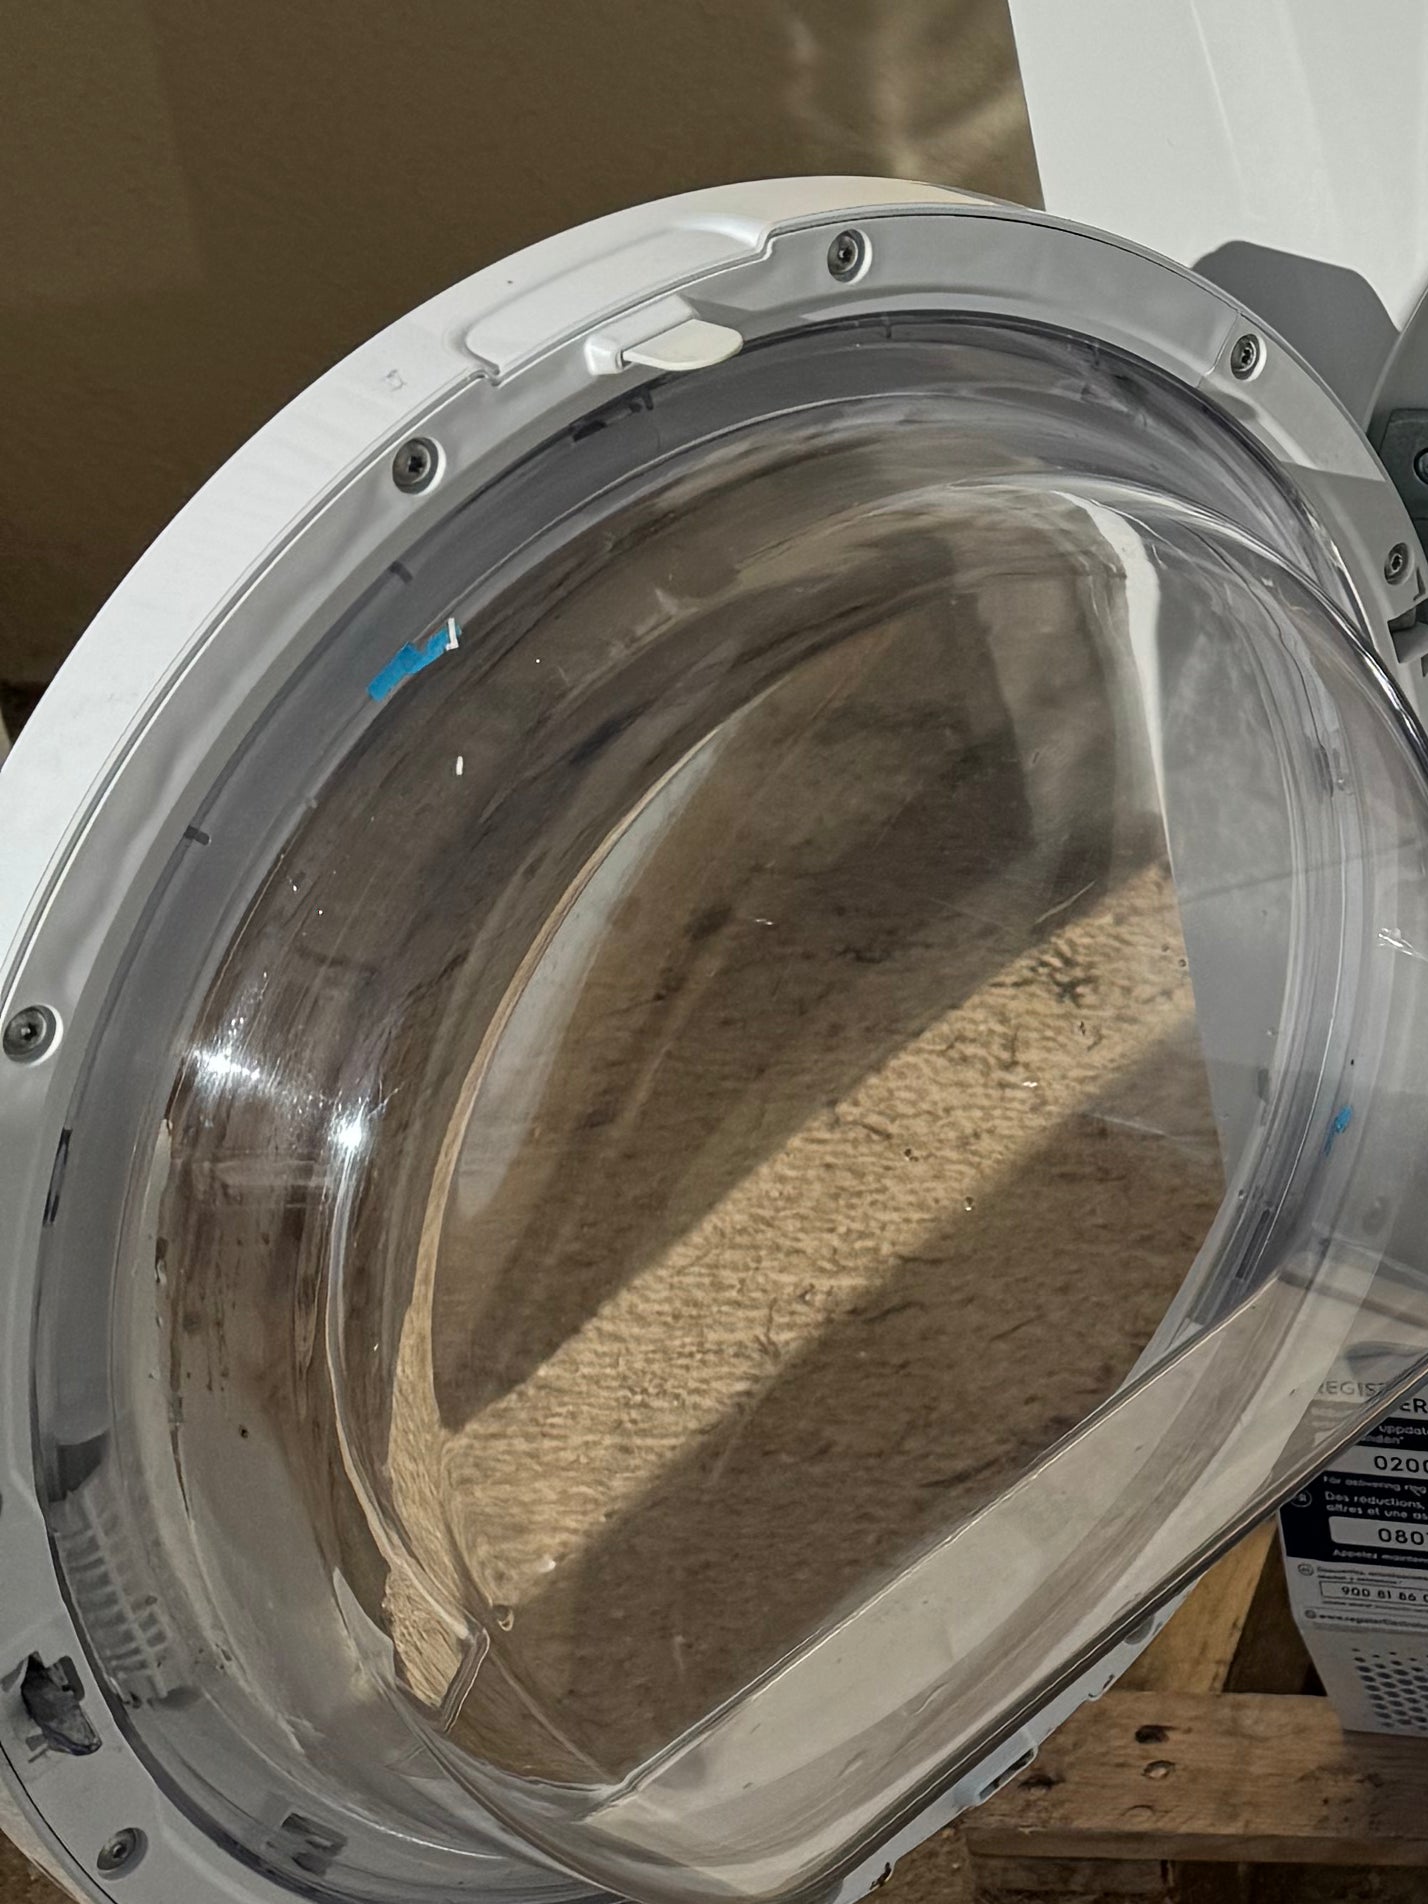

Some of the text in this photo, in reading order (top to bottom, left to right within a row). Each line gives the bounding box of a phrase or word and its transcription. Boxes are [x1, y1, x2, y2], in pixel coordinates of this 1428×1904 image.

[1324, 1491, 1350, 1503] Des
[1367, 1506, 1381, 1517] et
[1384, 1509, 1410, 1520] une
[1341, 1585, 1371, 1598] 900
[1377, 1589, 1392, 1600] 81
